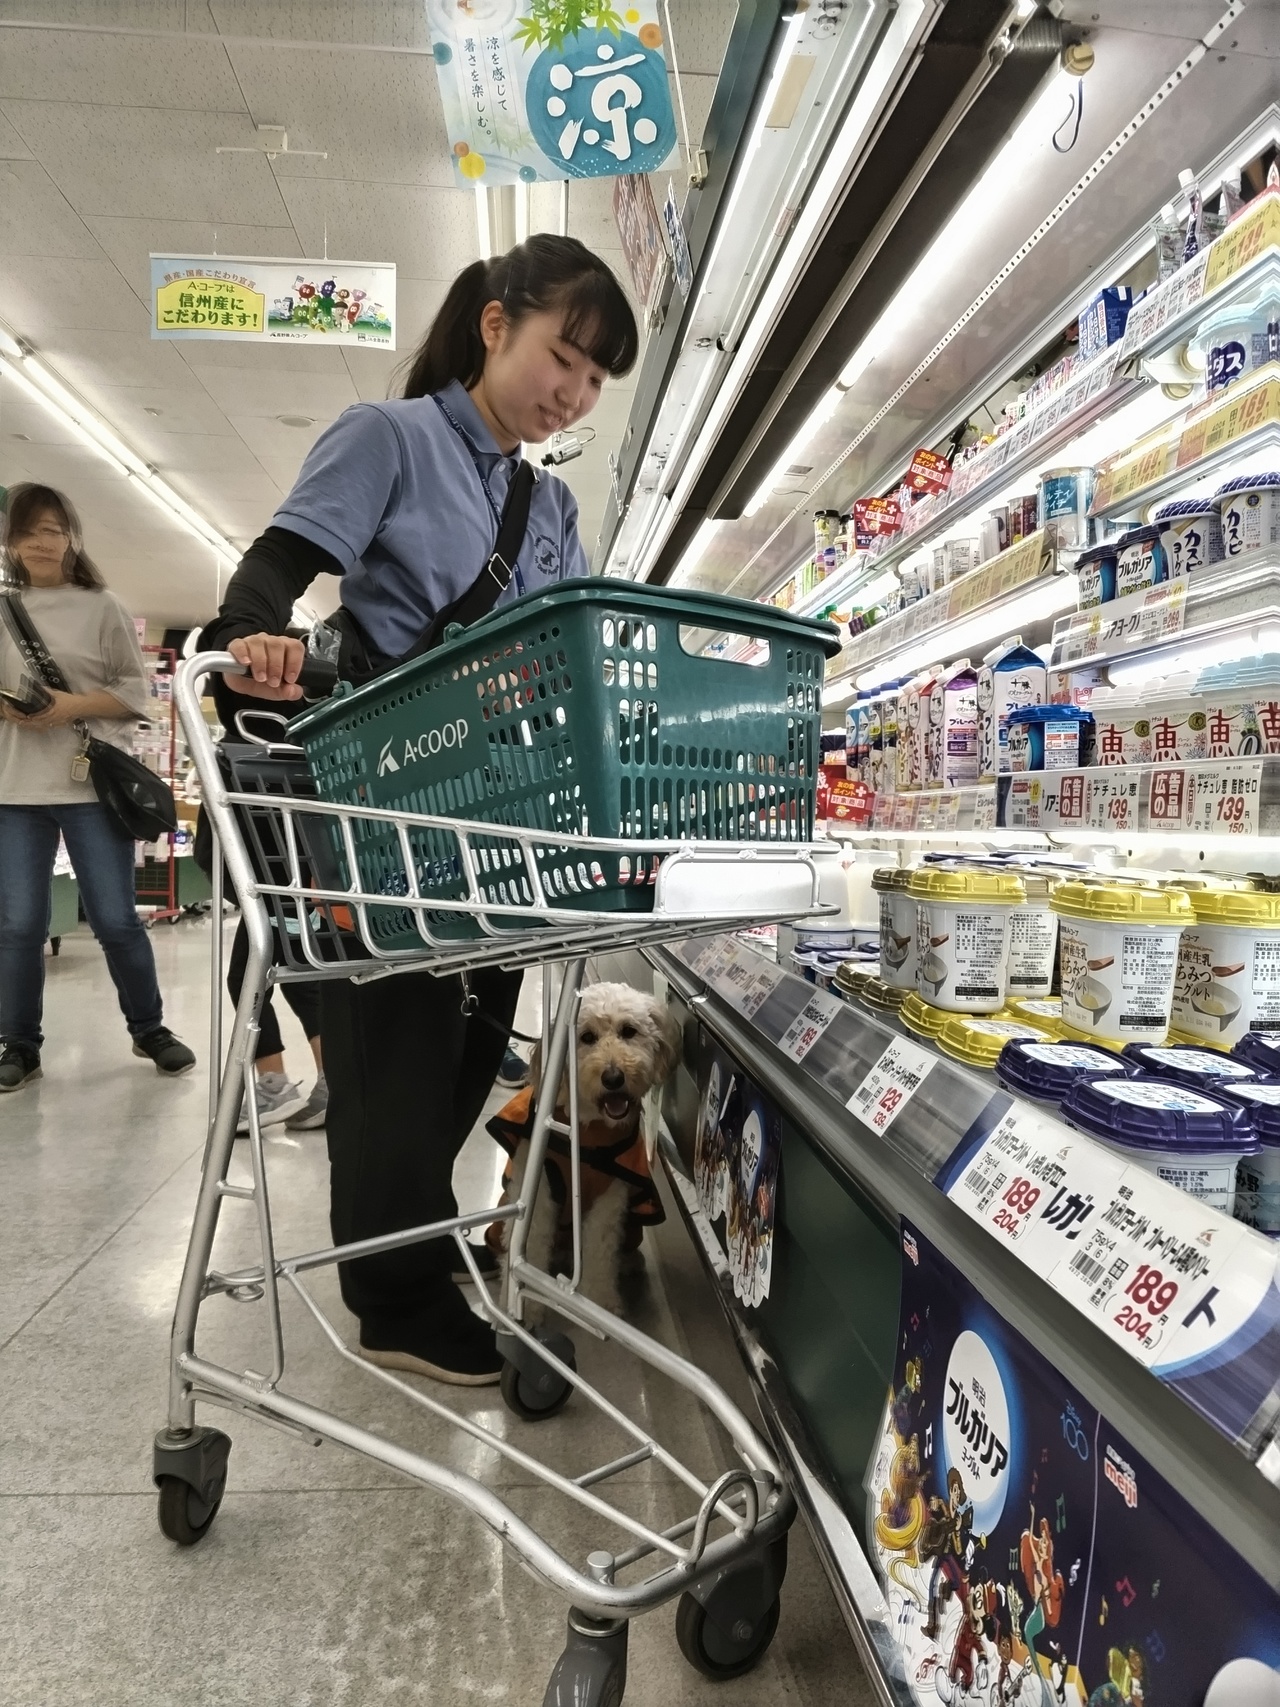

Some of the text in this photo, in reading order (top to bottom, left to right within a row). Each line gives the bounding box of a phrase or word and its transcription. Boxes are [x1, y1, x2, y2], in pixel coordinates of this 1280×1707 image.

[463, 38, 492, 137] 暑さを楽しむ。
[485, 36, 509, 111] 涼を感じて
[546, 43, 658, 161] 涼
[179, 292, 245, 311] 信州産に
[1226, 507, 1243, 556] カスピ
[1118, 555, 1152, 578] ブルガリア
[984, 714, 993, 770] プレーン
[1098, 723, 1134, 765] 恵
[1151, 717, 1188, 760] 恵
[1093, 783, 1137, 797] ナチュレ恵
[1060, 976, 1087, 996] ーグルト
[1117, 1185, 1134, 1201] 明治
[971, 1376, 987, 1409] 明治
[945, 1376, 1009, 1478] ブルガリア
[1059, 1412, 1089, 1461] 100
[961, 1446, 981, 1481] ヨーグルト
[1103, 1456, 1139, 1509] meiji
